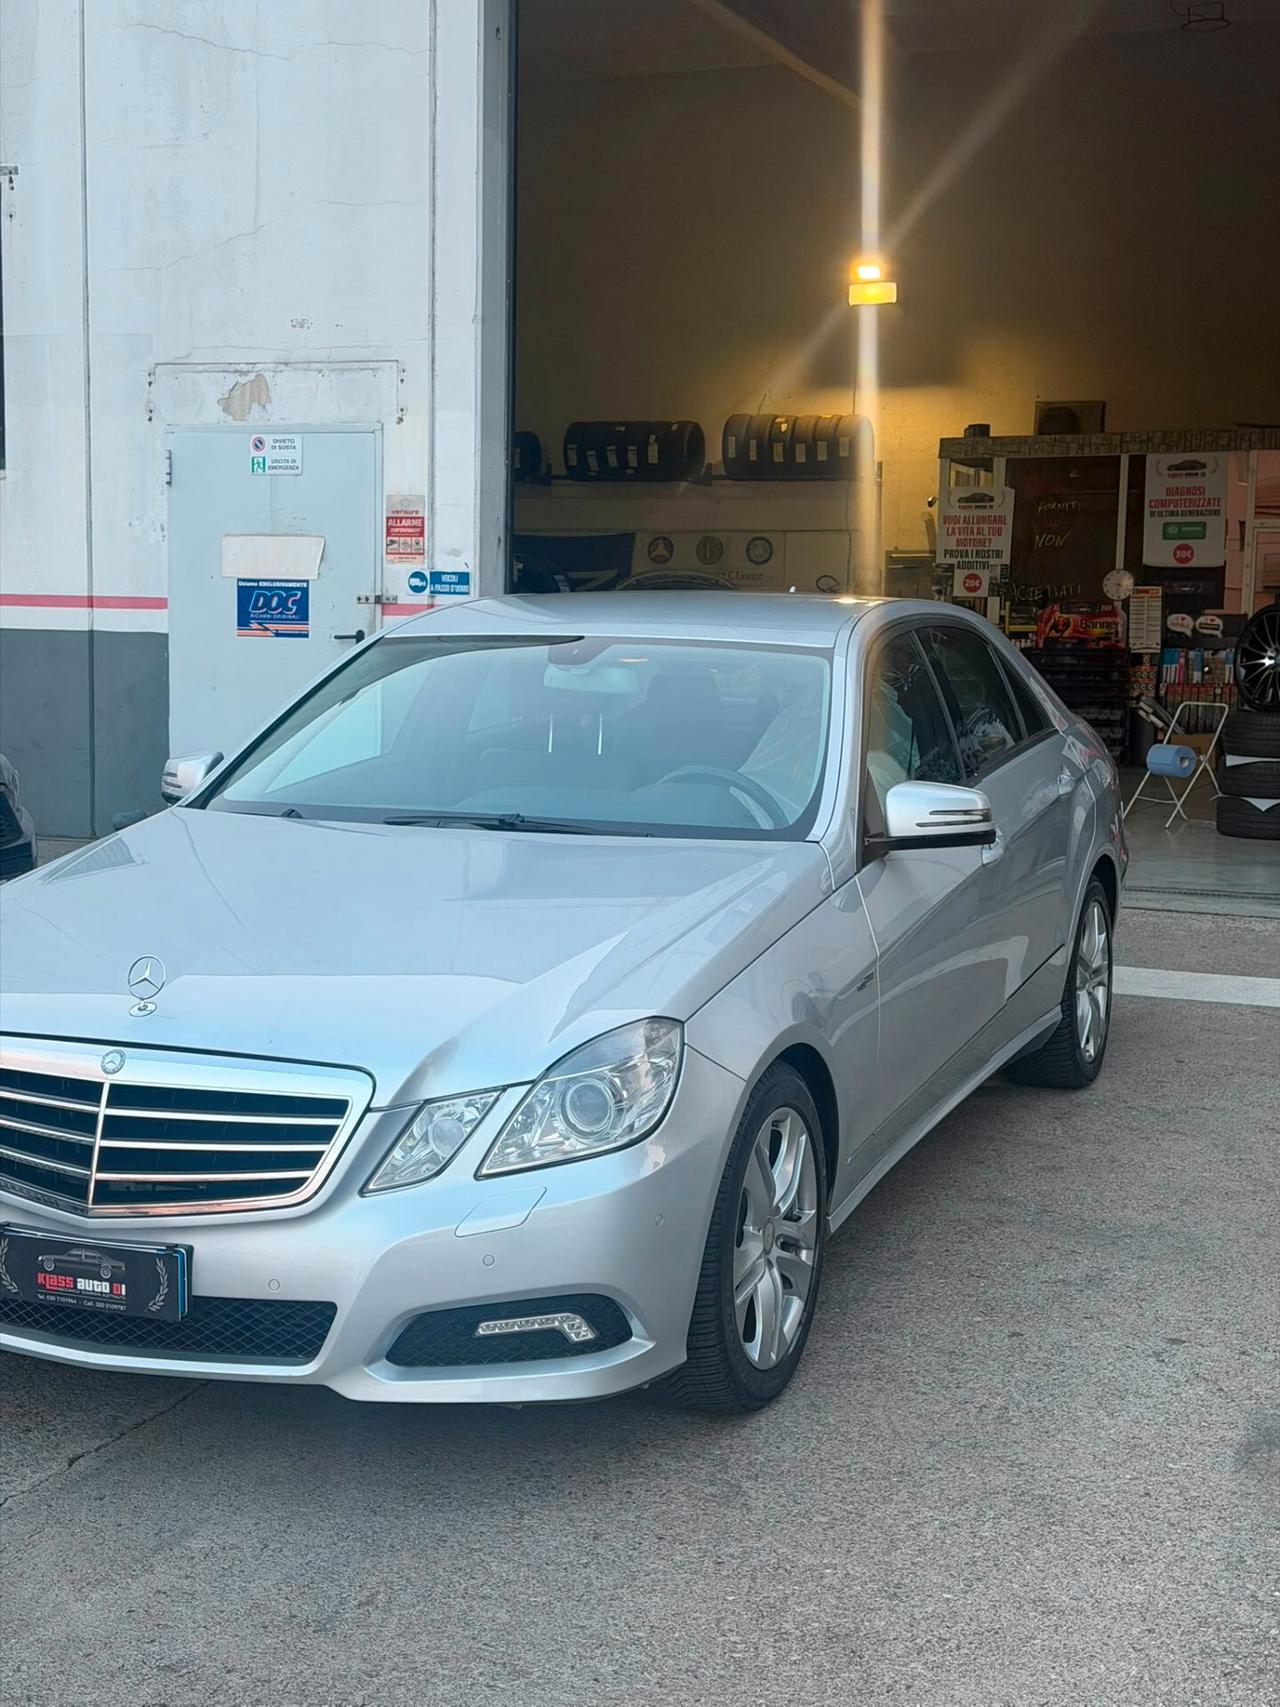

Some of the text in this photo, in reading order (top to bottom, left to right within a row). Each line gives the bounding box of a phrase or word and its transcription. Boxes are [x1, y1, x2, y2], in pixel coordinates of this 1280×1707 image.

[1166, 486, 1205, 496] DIAGNOSI
[1149, 498, 1222, 508] COMPUTERIZZATE
[388, 518, 422, 527] ALLARME
[943, 515, 1007, 525] VUOI ALLUNGARE
[947, 526, 1003, 536] LA VITA AL TUO
[956, 538, 992, 548] MOTORE?
[944, 549, 969, 559] PROVA
[976, 549, 1003, 559] NOSTRI
[956, 561, 989, 570] ADDITIVI
[435, 584, 450, 592] PASSO
[451, 584, 469, 592] D'UOMO
[249, 590, 301, 614] DOC
[1080, 618, 1118, 629] Banner
[77, 1278, 110, 1293] auto
